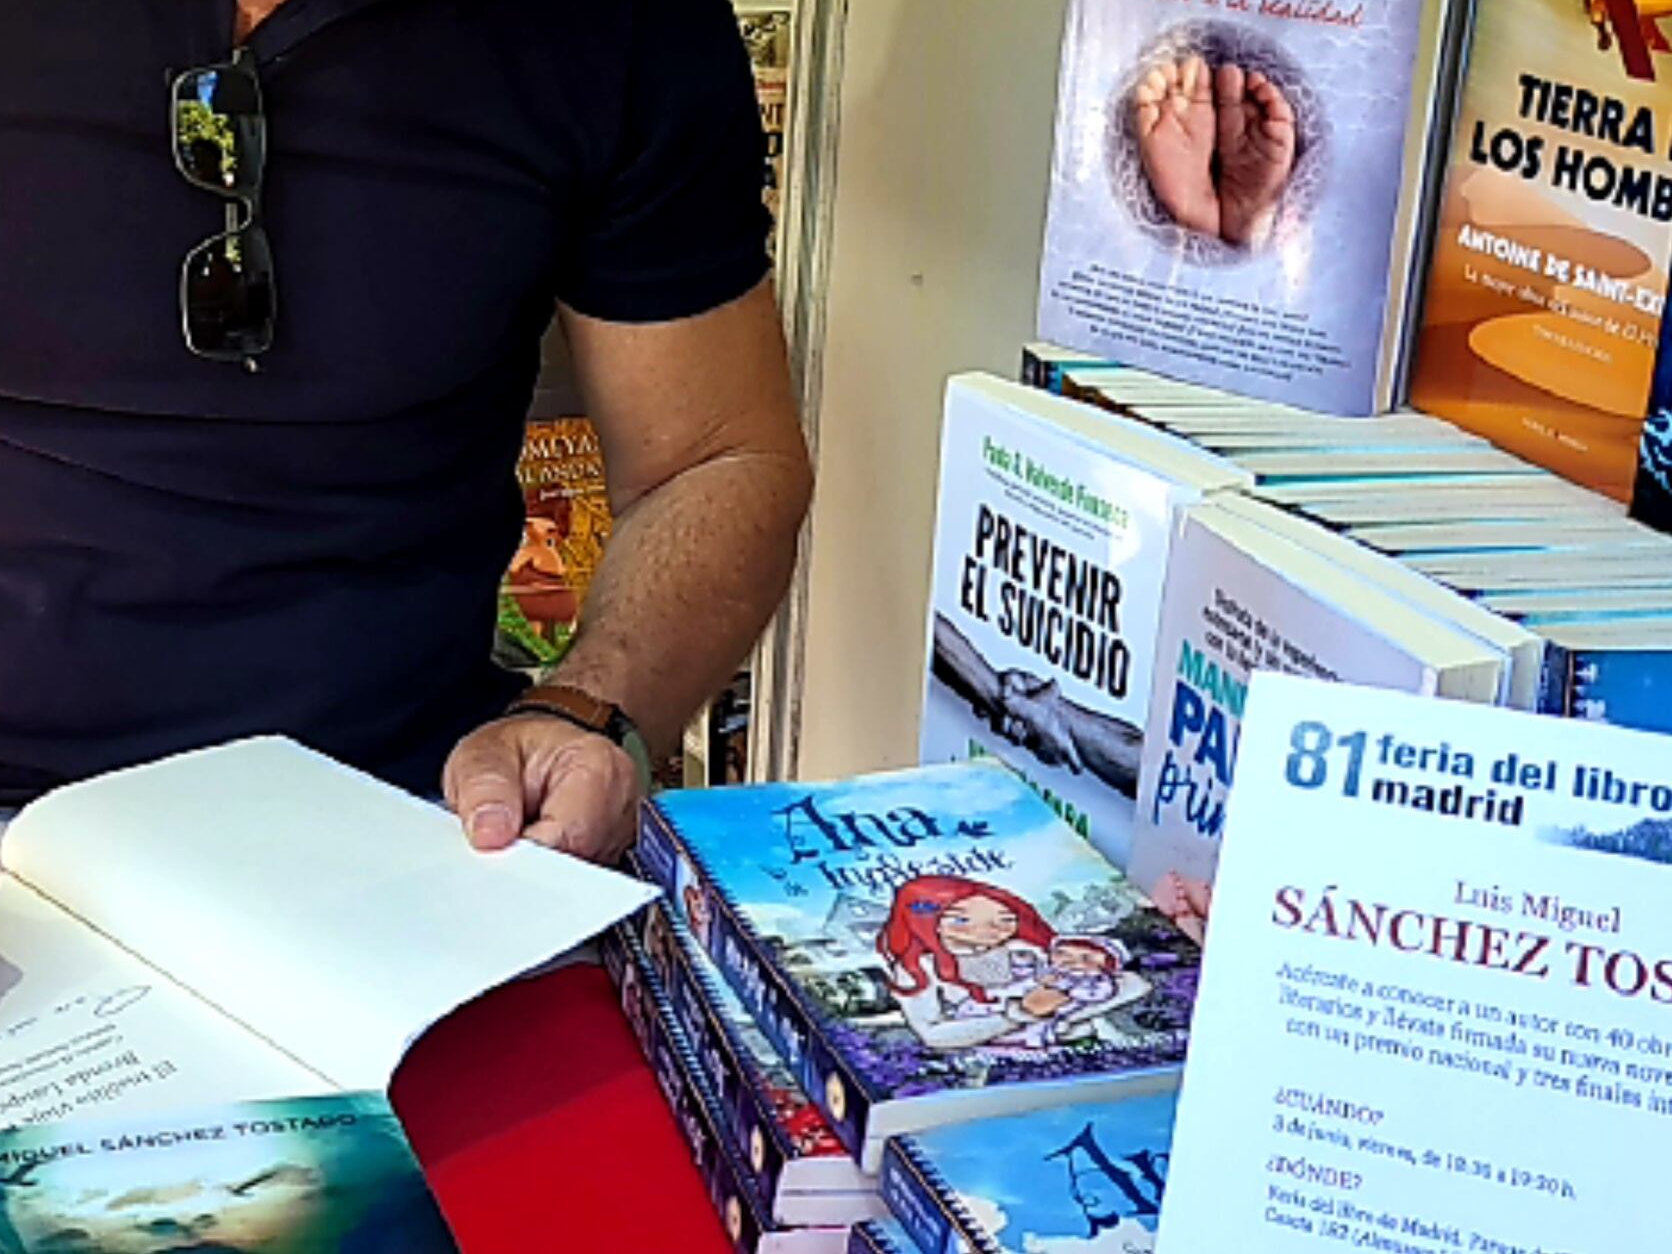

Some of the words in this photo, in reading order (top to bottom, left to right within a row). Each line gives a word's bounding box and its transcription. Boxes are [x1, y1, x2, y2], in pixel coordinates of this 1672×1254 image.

[1518, 74, 1655, 154] TIERRA
[1470, 120, 1546, 180] LOS
[1457, 224, 1542, 273] ANTOINE
[1544, 253, 1570, 283] DE
[974, 503, 1123, 634] PREVENIR
[960, 553, 991, 623] EL
[997, 580, 1131, 699] SUICIDIO
[1283, 720, 1369, 798] 81
[1375, 733, 1475, 778] feria
[1491, 752, 1558, 793] del
[770, 794, 945, 865] Ana
[1371, 777, 1525, 827] madrid
[1454, 880, 1514, 914] Luis
[1521, 891, 1622, 935] Miguel
[1271, 884, 1552, 980] SÁNCHEZ
[1564, 941, 1672, 1006] TOS
[1361, 981, 1374, 997] a
[1378, 985, 1456, 1012] conocer
[1458, 999, 1470, 1016] a
[1475, 1002, 1502, 1023] un
[1505, 1009, 1560, 1034] autor
[1564, 1021, 1600, 1044] con
[1637, 1034, 1672, 1058] obr
[1450, 1020, 1528, 1055] firmada
[1533, 1043, 1557, 1063] su
[1560, 1048, 1621, 1075] nueva
[1625, 1063, 1672, 1087] nove
[1286, 1017, 1321, 1039] con
[1325, 1025, 1350, 1047] un
[1353, 1031, 1425, 1062] premio
[1427, 1048, 1513, 1080] nacional
[1515, 1066, 1528, 1088] y
[1532, 1069, 1571, 1093] tres
[1575, 1073, 1642, 1108] finales
[99, 1123, 229, 1153] SÁNCHEZ
[233, 1112, 358, 1137] TOSTADO
[1274, 1086, 1385, 1126] ¿CUÁNDO?
[1265, 1154, 1363, 1191] ¿DÓNDE?
